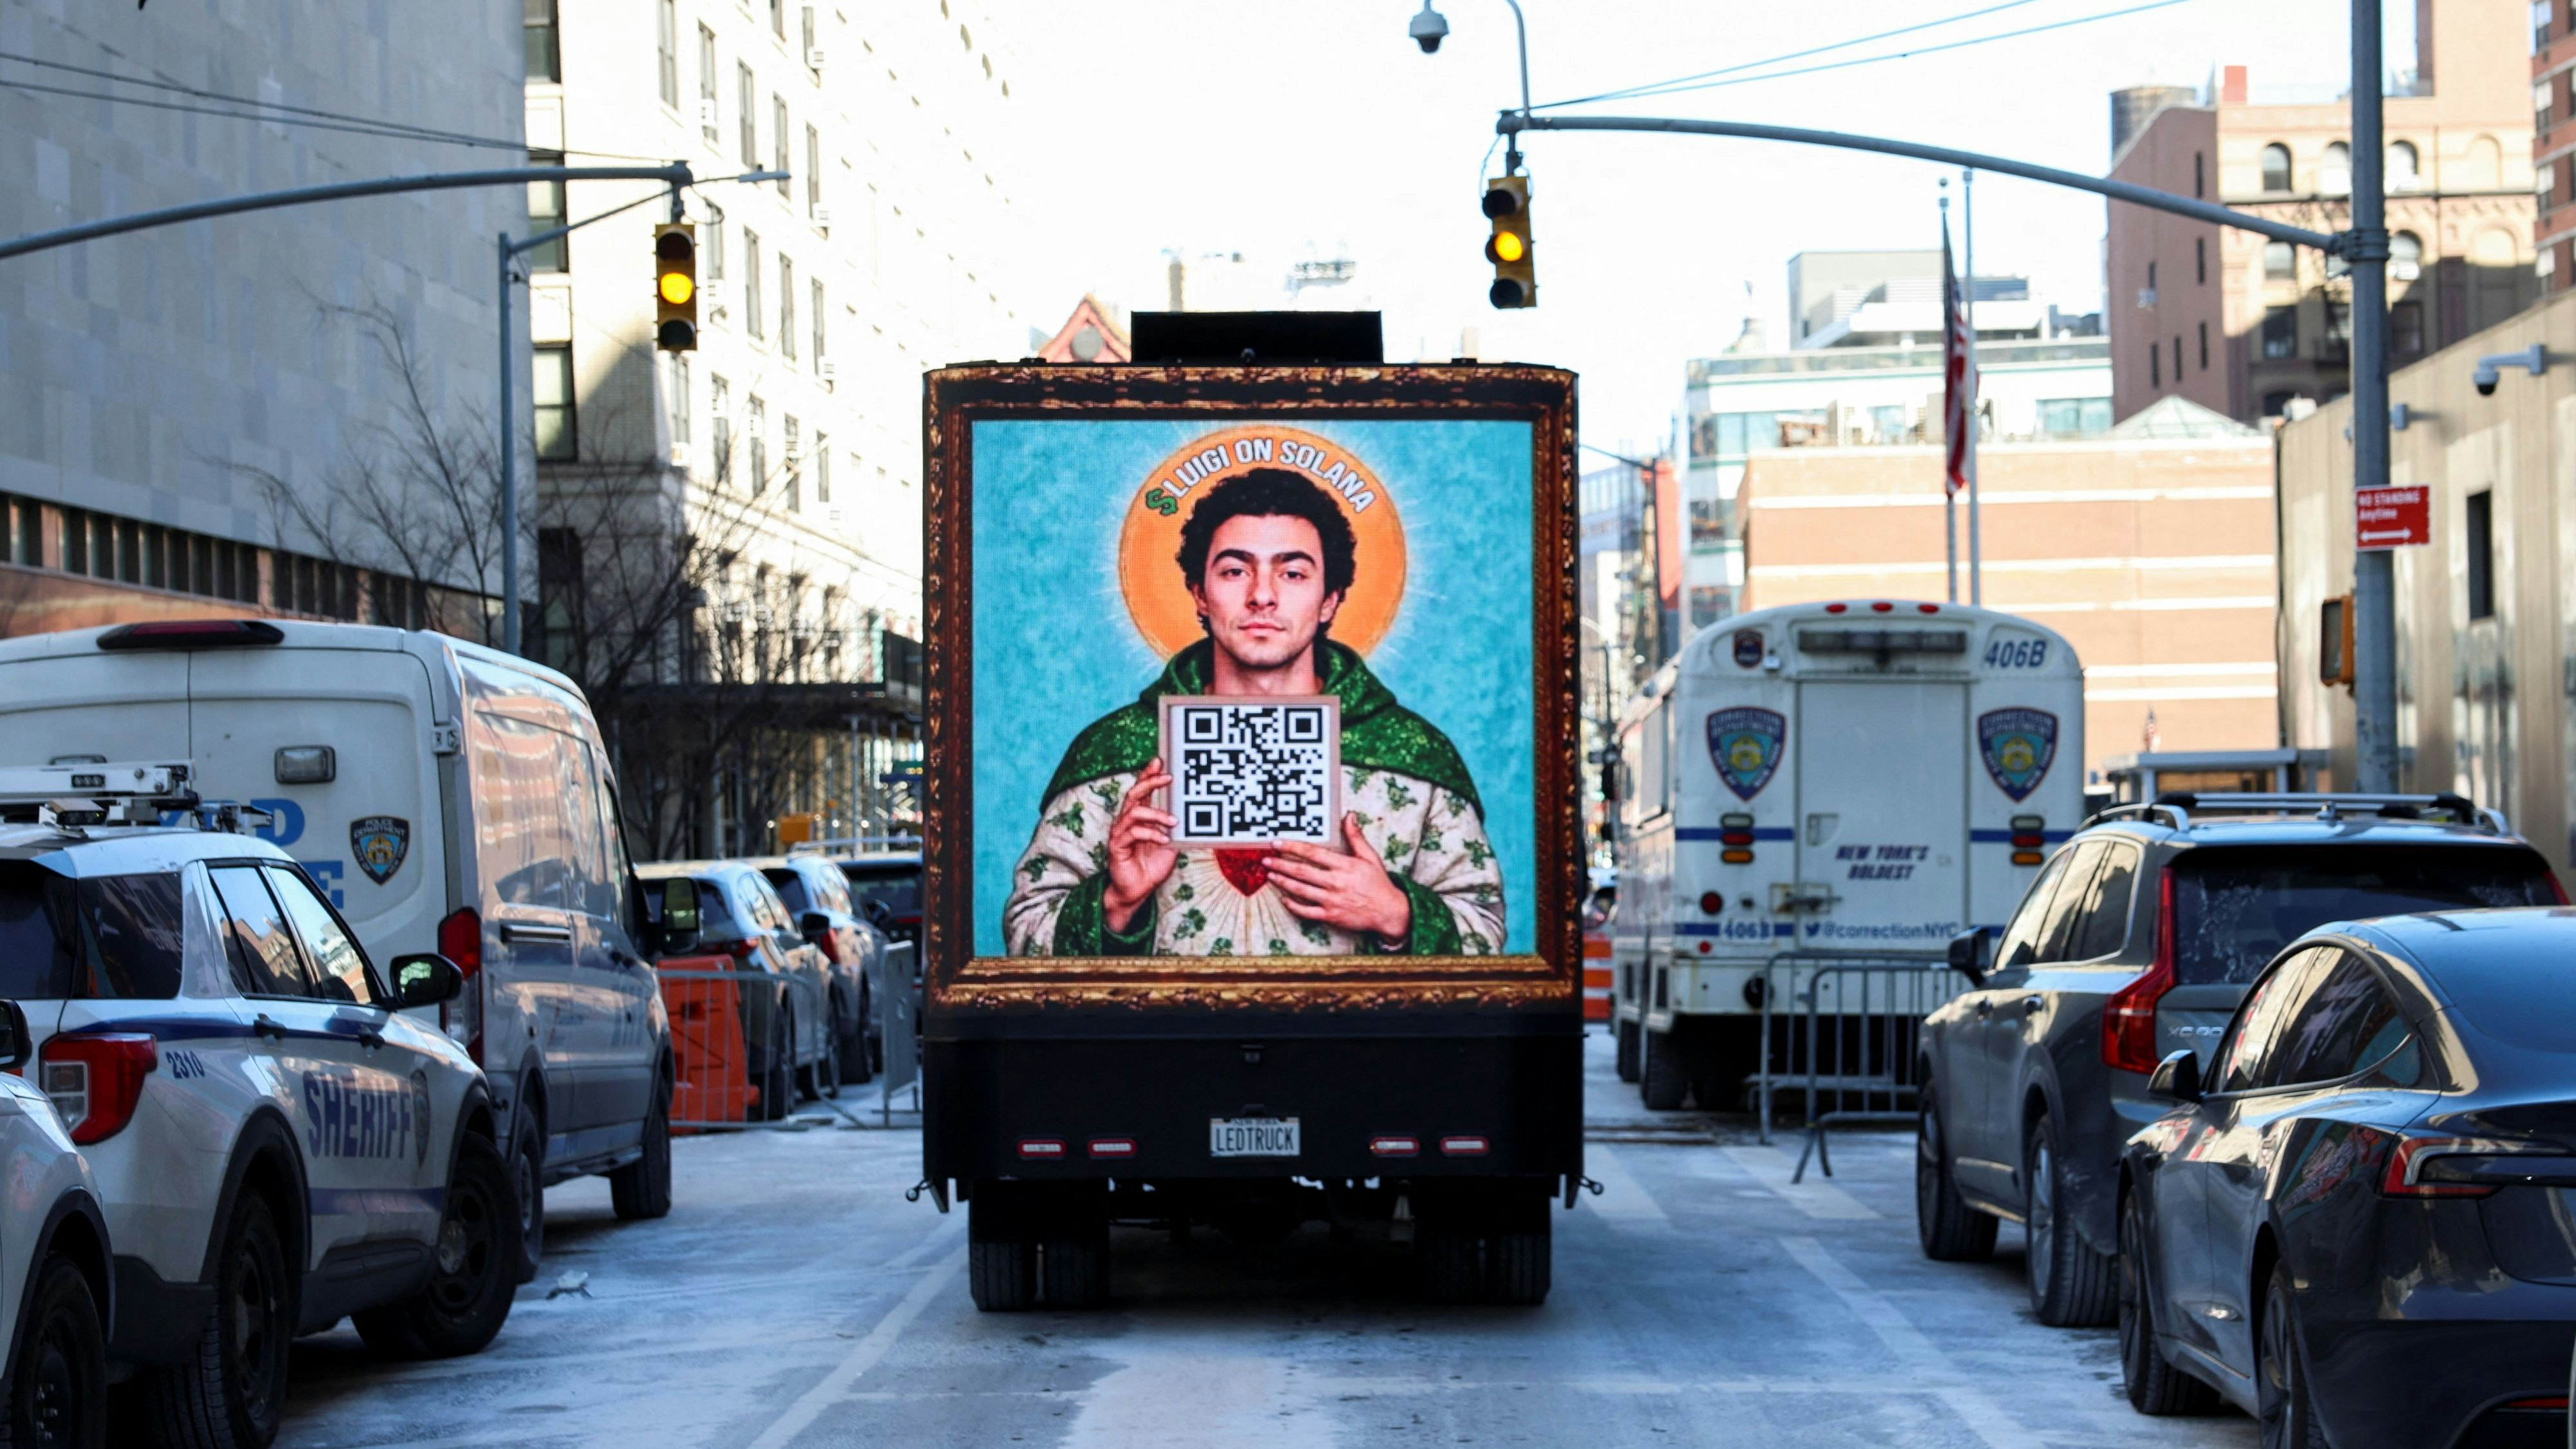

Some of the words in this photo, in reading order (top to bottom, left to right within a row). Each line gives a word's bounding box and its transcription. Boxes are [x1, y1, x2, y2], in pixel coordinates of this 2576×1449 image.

[1233, 439, 1273, 464] ON
[1279, 440, 1376, 514] SOLANA
[2359, 493, 2372, 506] NO
[2374, 491, 2420, 506] STANDING
[1984, 640, 2047, 668] 406B
[1836, 845, 1871, 860] NEW
[1875, 844, 1929, 861] YORK'S
[1847, 864, 1915, 880] BOLDEST
[1823, 921, 1959, 940] @correctionNYC
[166, 1050, 205, 1080] 2310
[303, 1070, 412, 1159] SHERIFF
[1216, 1128, 1294, 1151] LEDTRUCK
